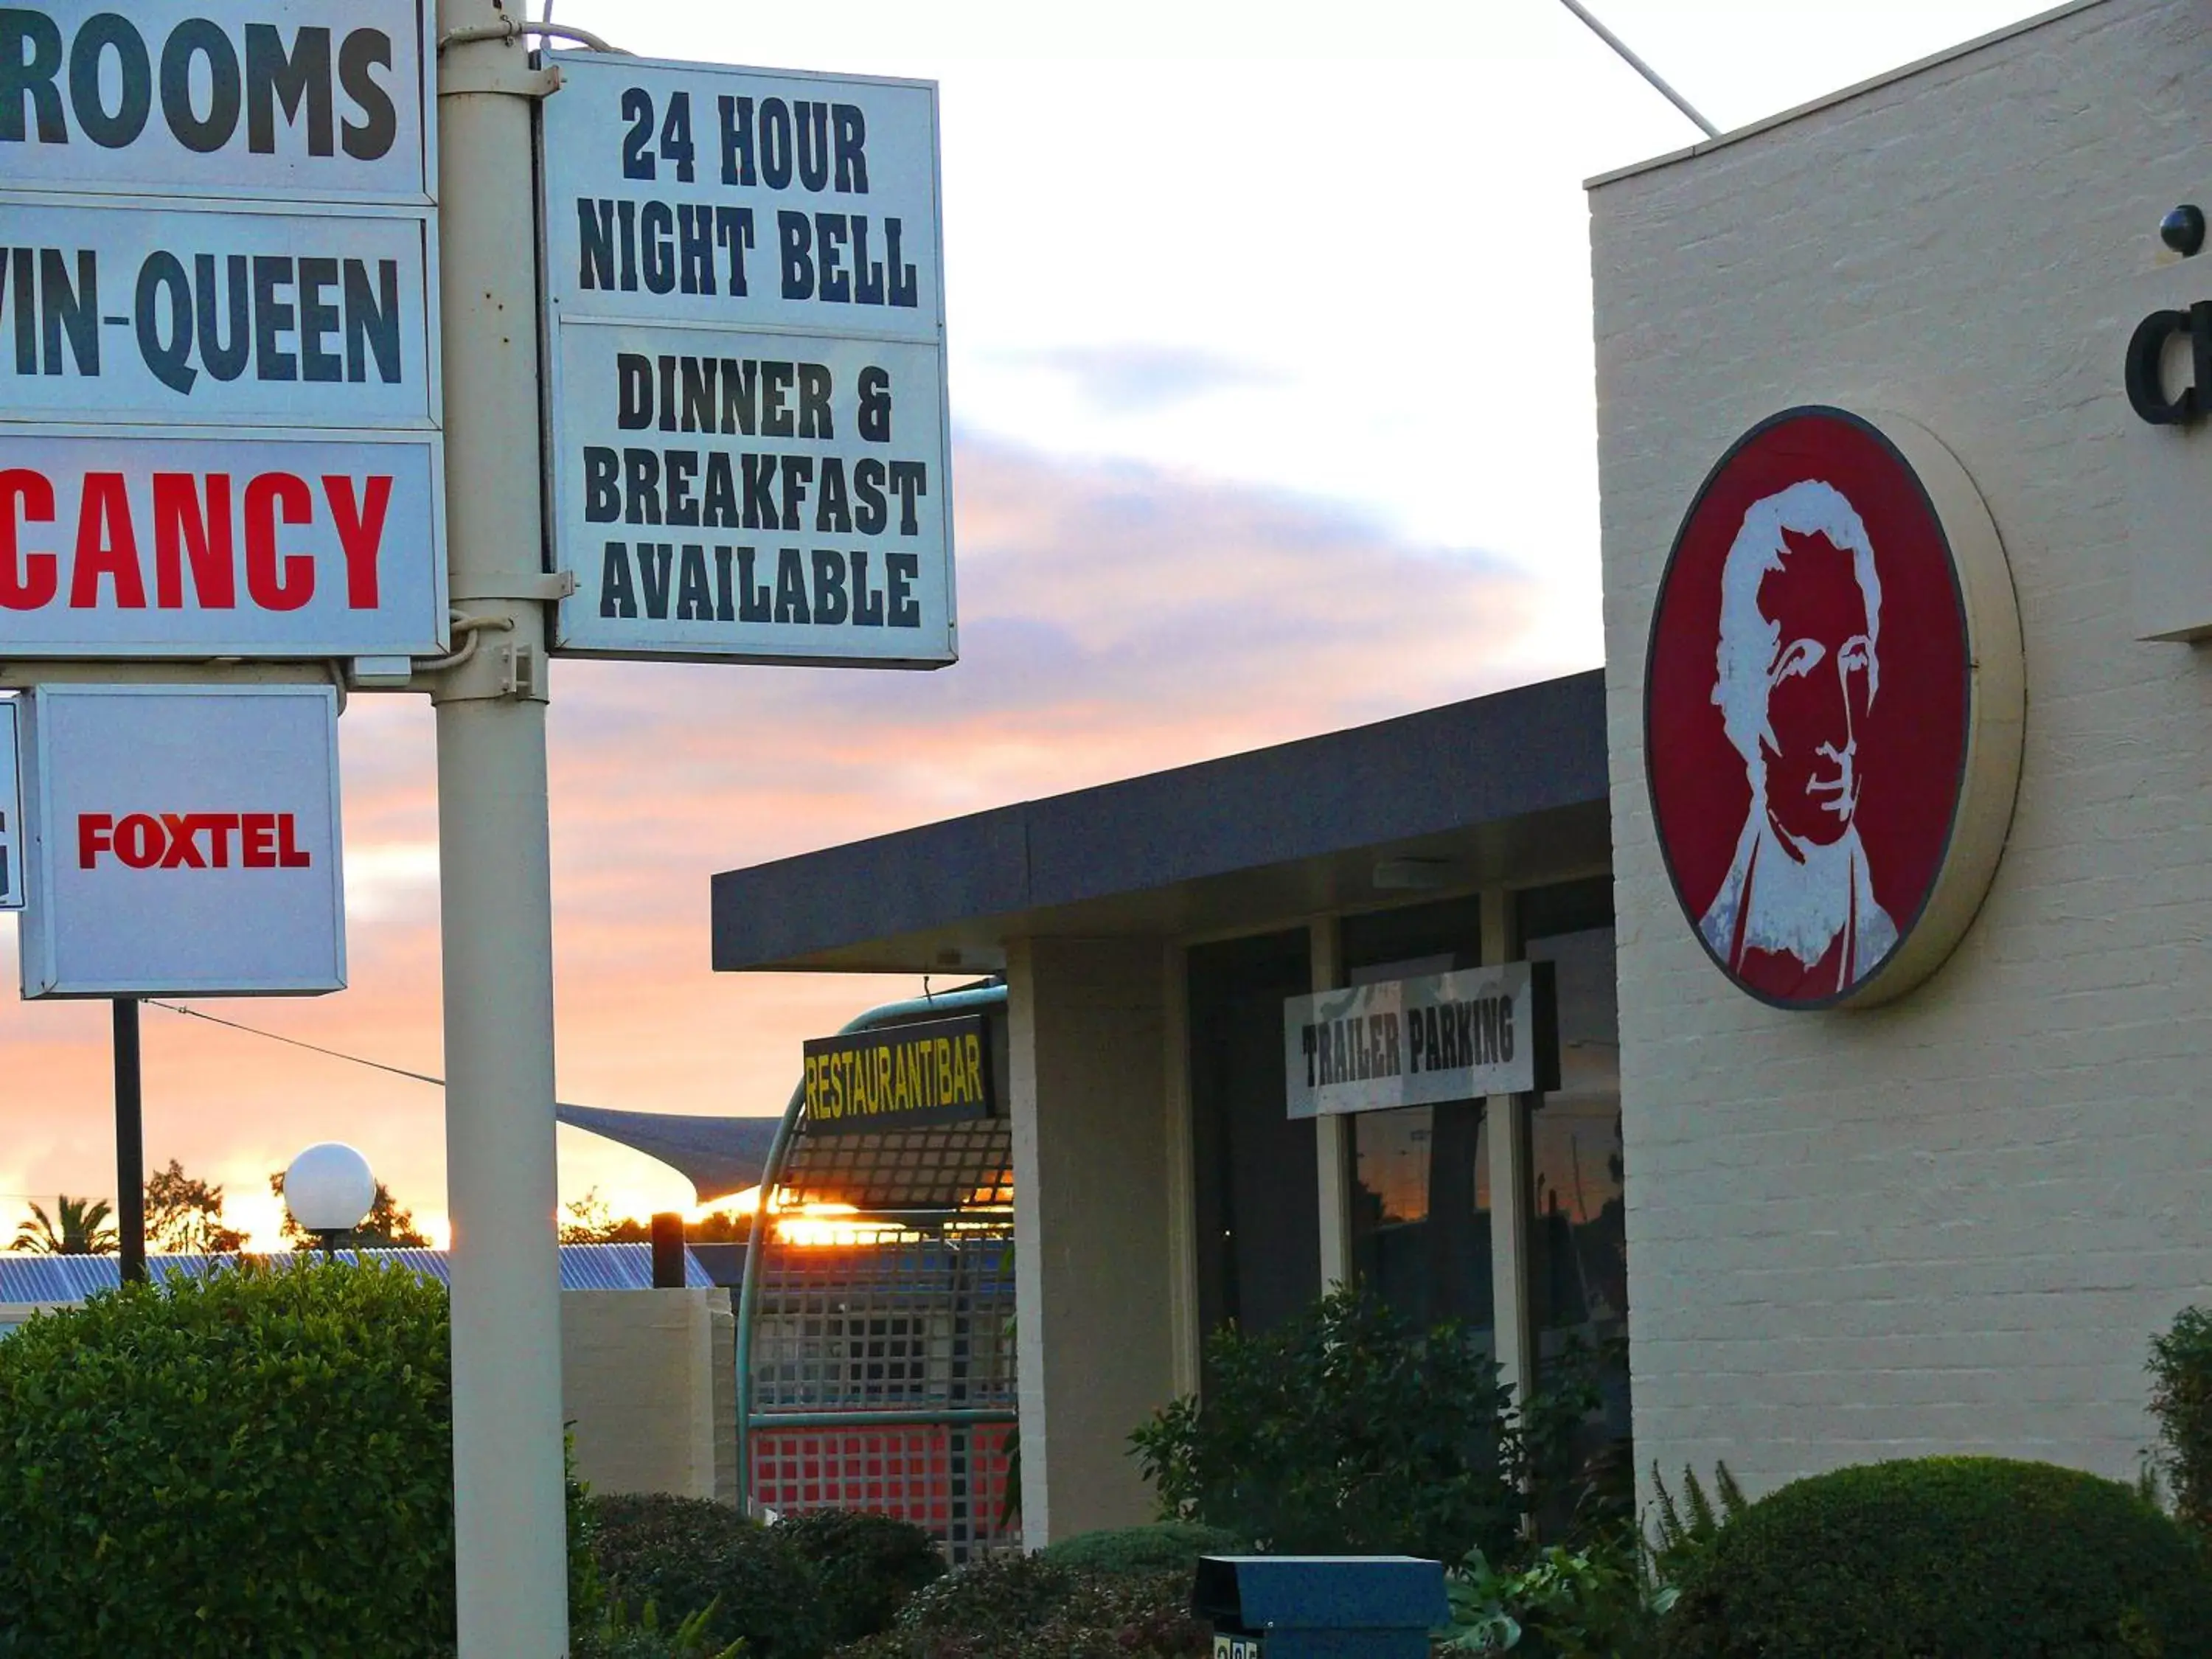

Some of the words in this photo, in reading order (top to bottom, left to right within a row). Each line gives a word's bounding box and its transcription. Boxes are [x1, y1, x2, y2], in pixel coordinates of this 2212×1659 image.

[0, 9, 397, 161] ROOMS
[622, 88, 694, 183] 24
[718, 95, 869, 193] HOUR
[577, 198, 754, 296] NIGHT
[777, 210, 918, 307] BELL
[0, 247, 402, 395] IN-QUEEN
[617, 353, 834, 439] DINNER
[858, 366, 891, 442] &
[583, 446, 926, 536] BREAKFAST
[599, 542, 920, 627] AVAILABLE
[78, 814, 310, 869] FOXTEL
[1302, 1012, 1400, 1087] TRAILER
[1408, 995, 1514, 1074] PARKING
